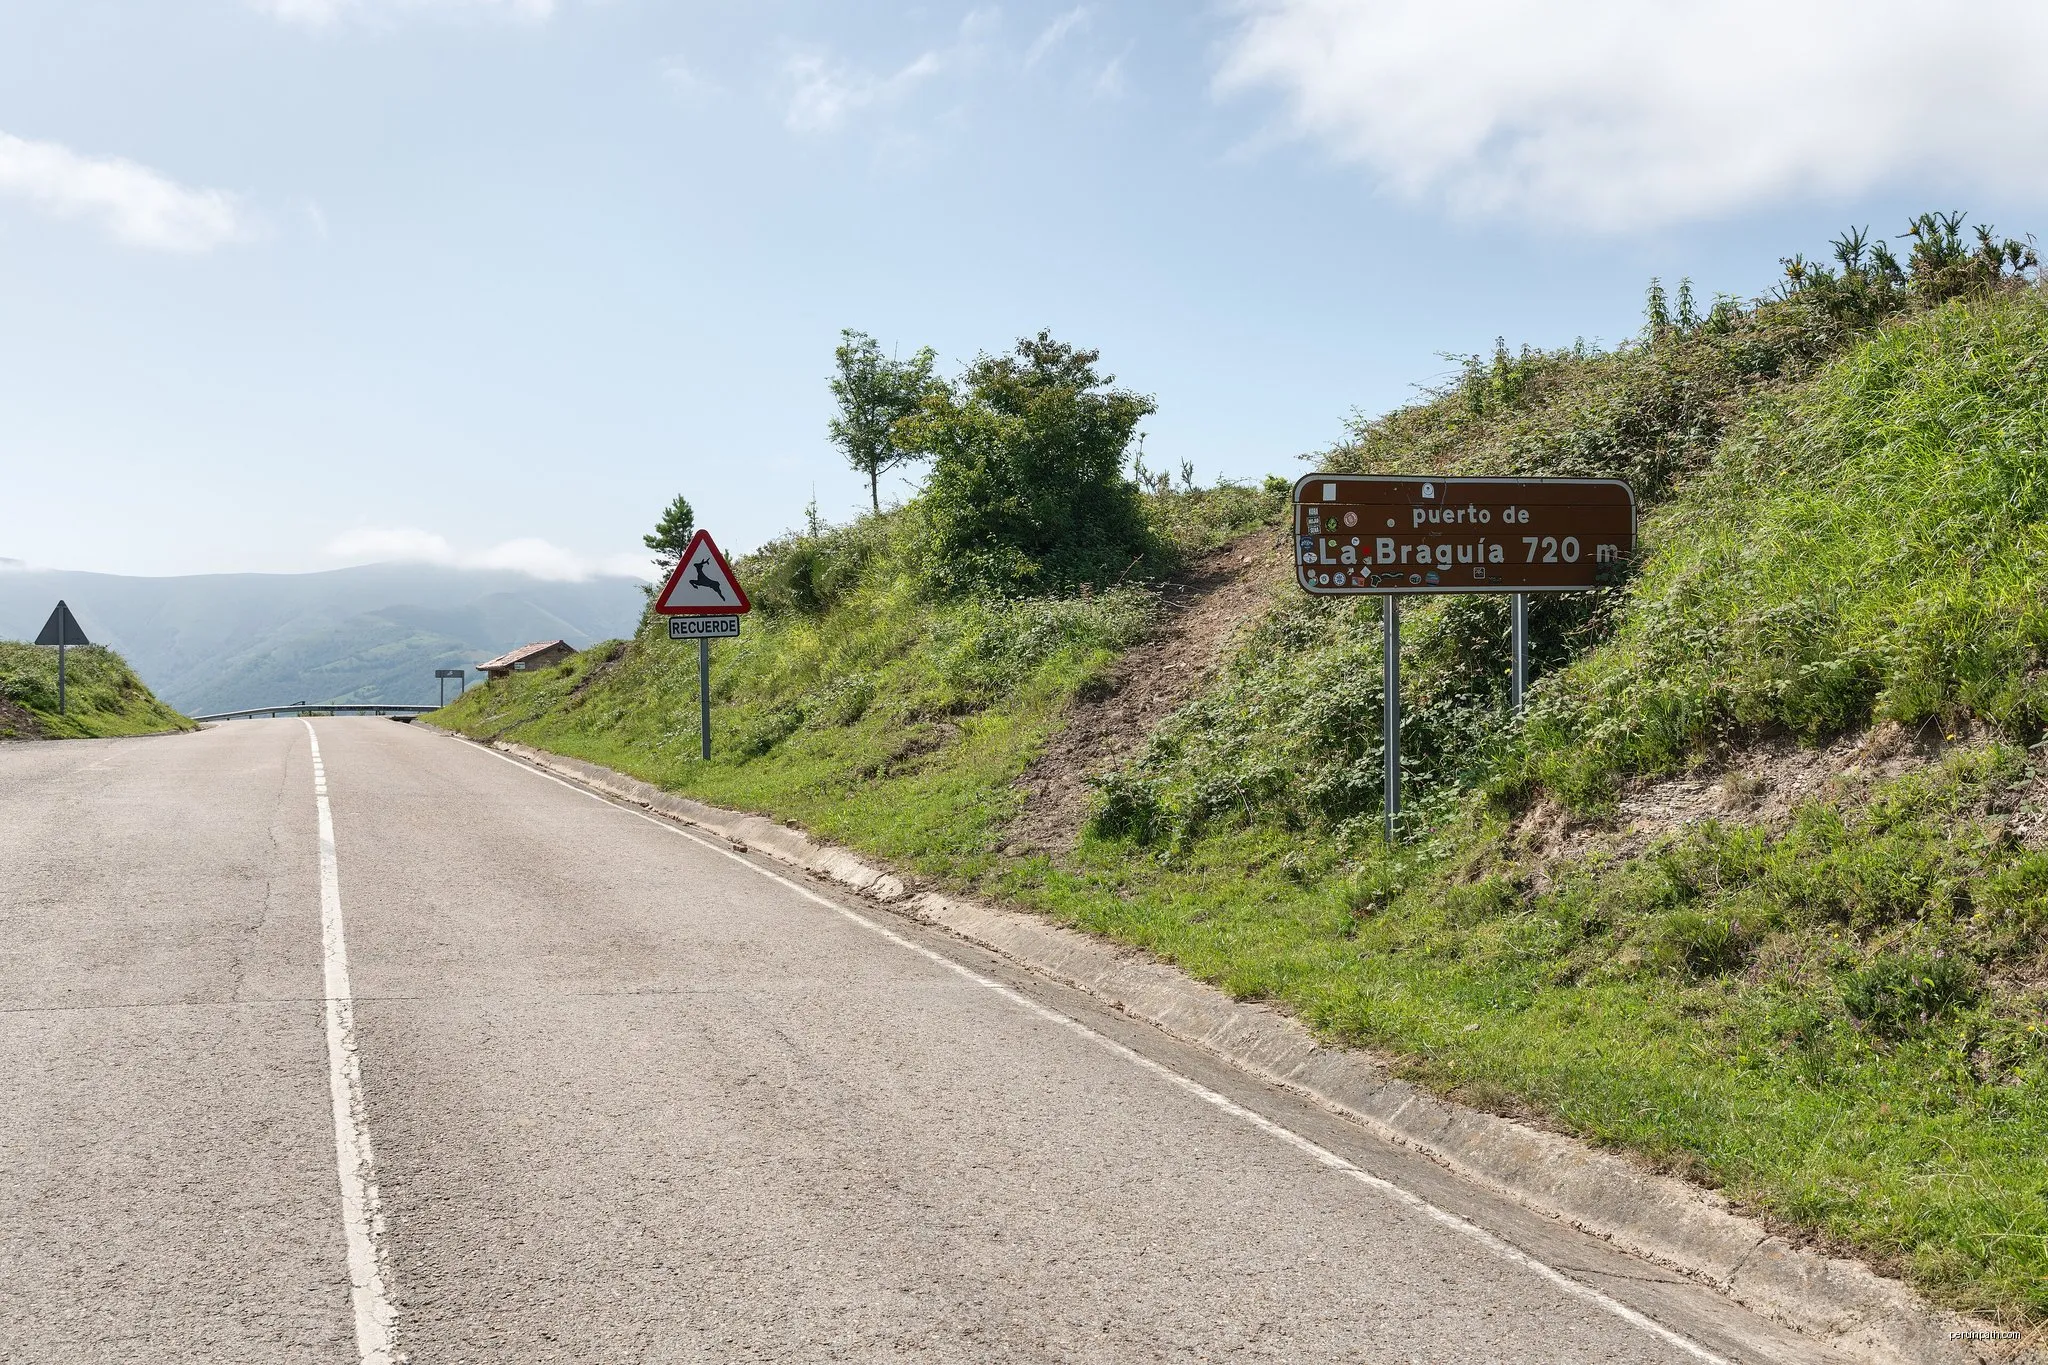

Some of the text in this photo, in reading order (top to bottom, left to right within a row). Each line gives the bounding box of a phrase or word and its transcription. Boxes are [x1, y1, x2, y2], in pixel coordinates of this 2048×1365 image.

[1413, 504, 1530, 528] puerto de
[1319, 536, 1618, 571] La Braguía 720 m
[672, 620, 737, 635] RECUERDE
